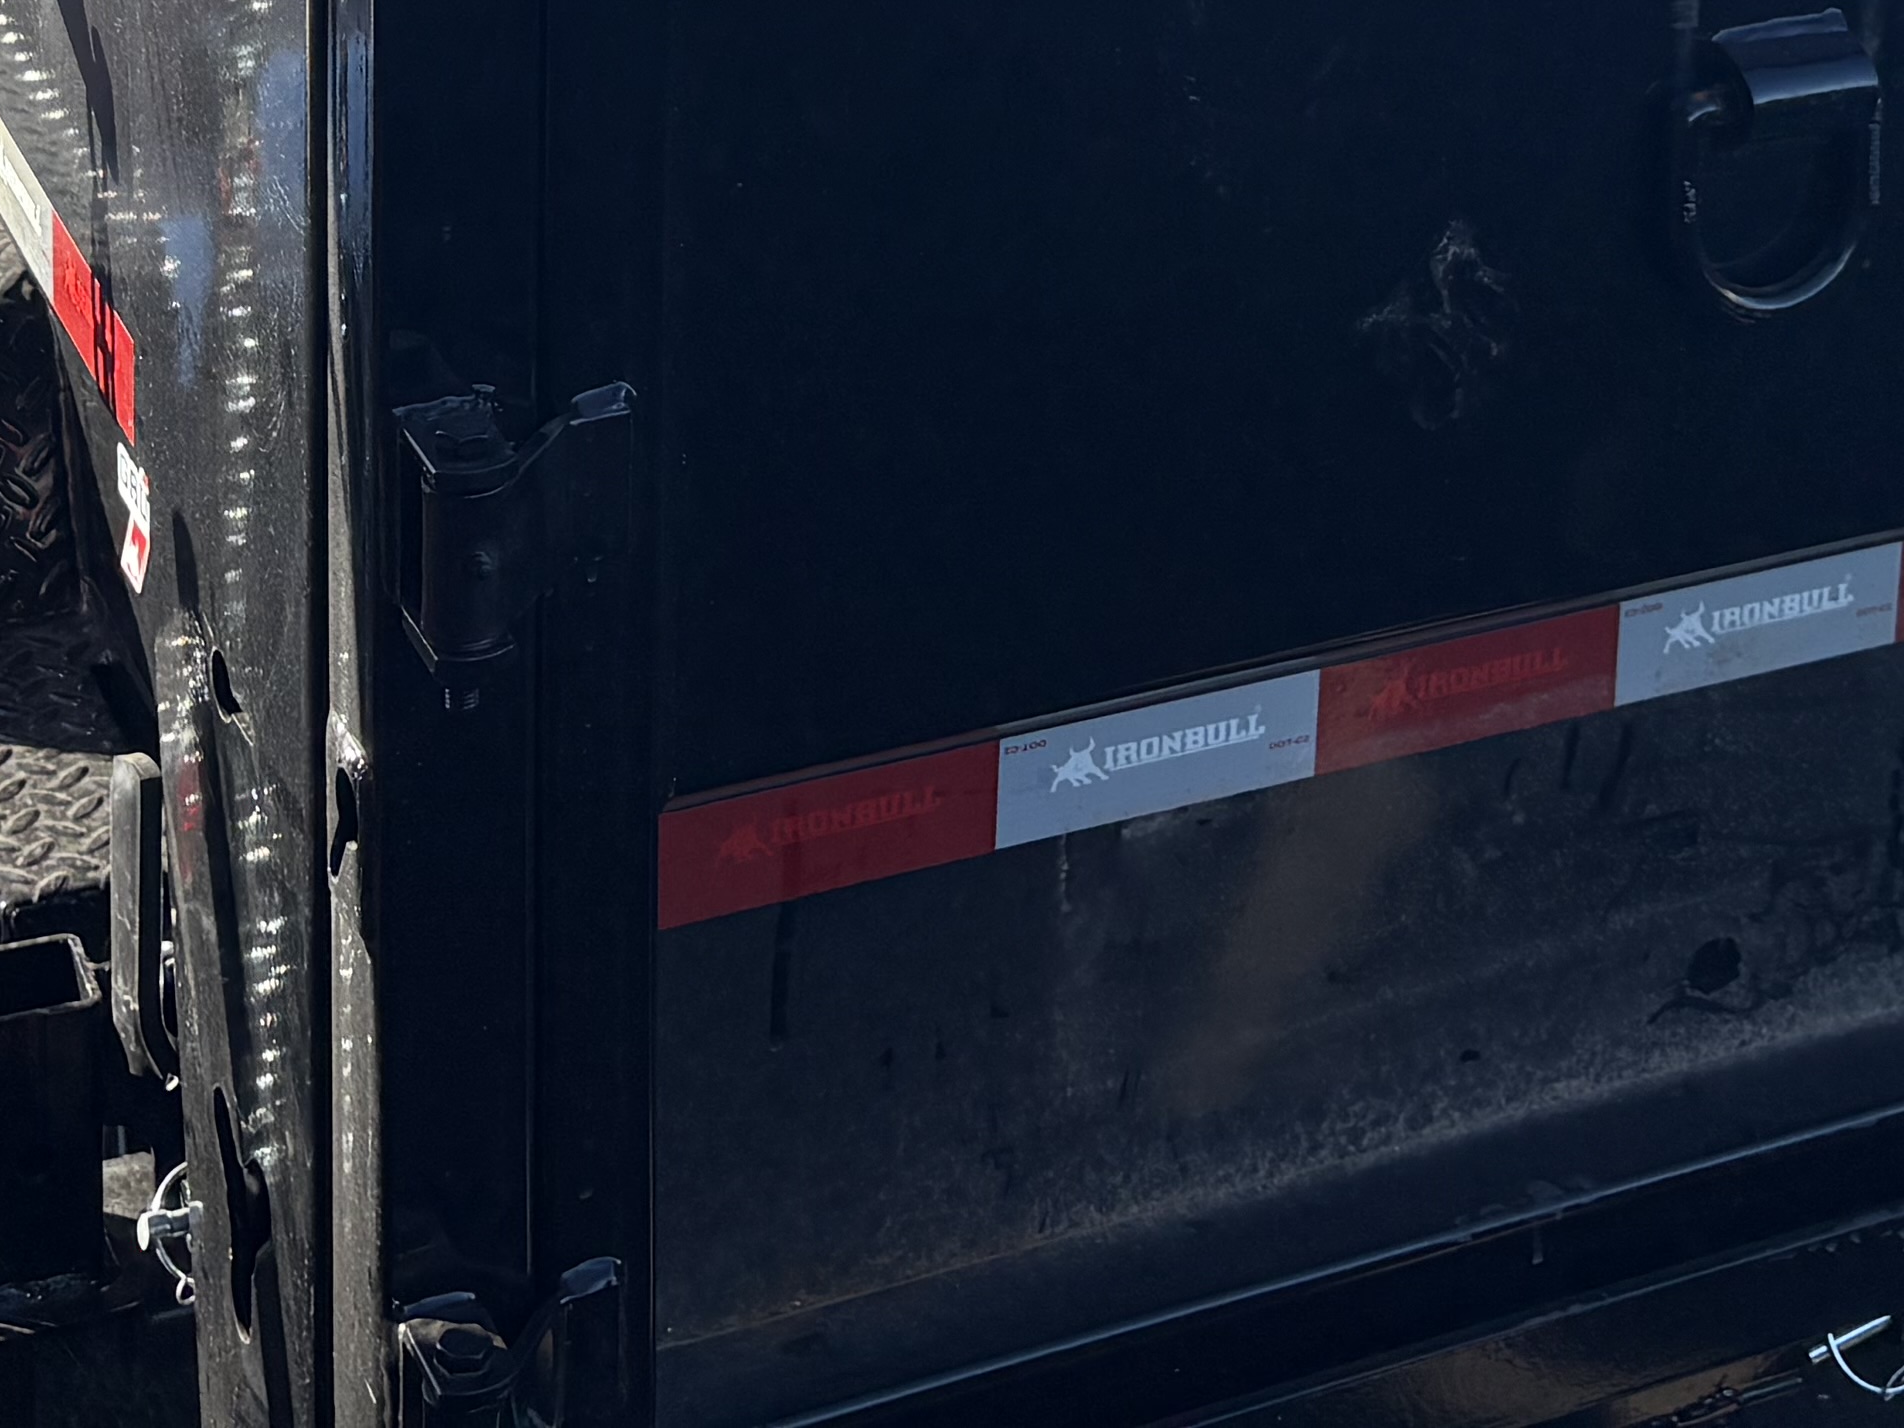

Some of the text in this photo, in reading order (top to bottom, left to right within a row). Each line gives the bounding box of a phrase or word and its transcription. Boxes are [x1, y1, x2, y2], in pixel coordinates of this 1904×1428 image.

[1711, 582, 1855, 634] IRONBULL
[1416, 647, 1569, 701] IRONBULL
[1103, 712, 1266, 771] IRONBULL
[768, 784, 945, 846] IRONBULL
